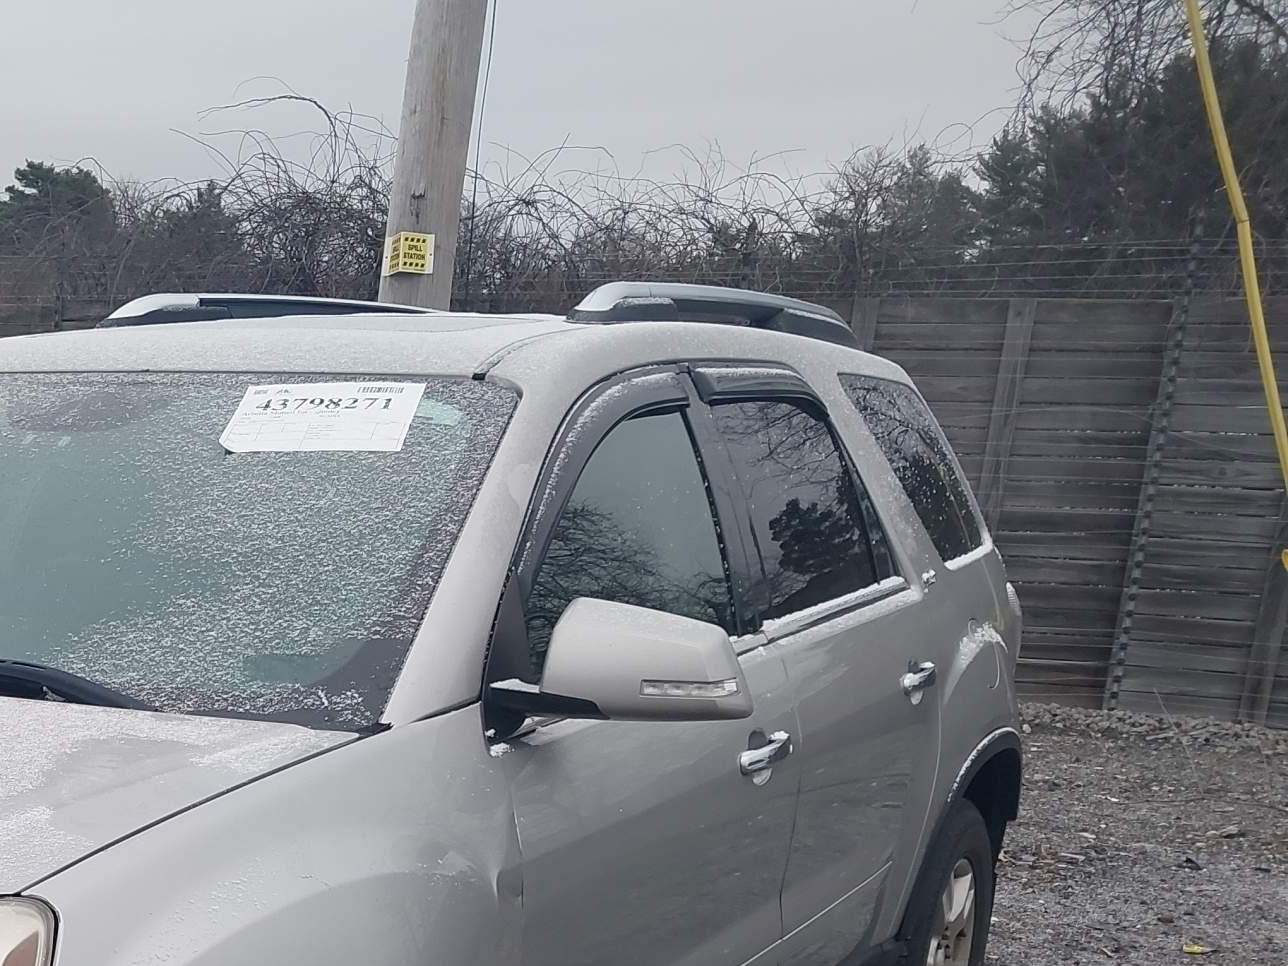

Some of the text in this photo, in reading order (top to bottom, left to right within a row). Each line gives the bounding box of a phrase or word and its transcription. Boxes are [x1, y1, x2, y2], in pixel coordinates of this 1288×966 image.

[407, 244, 423, 252] SPILL
[403, 252, 425, 260] STATION
[255, 396, 393, 411] 43798271
